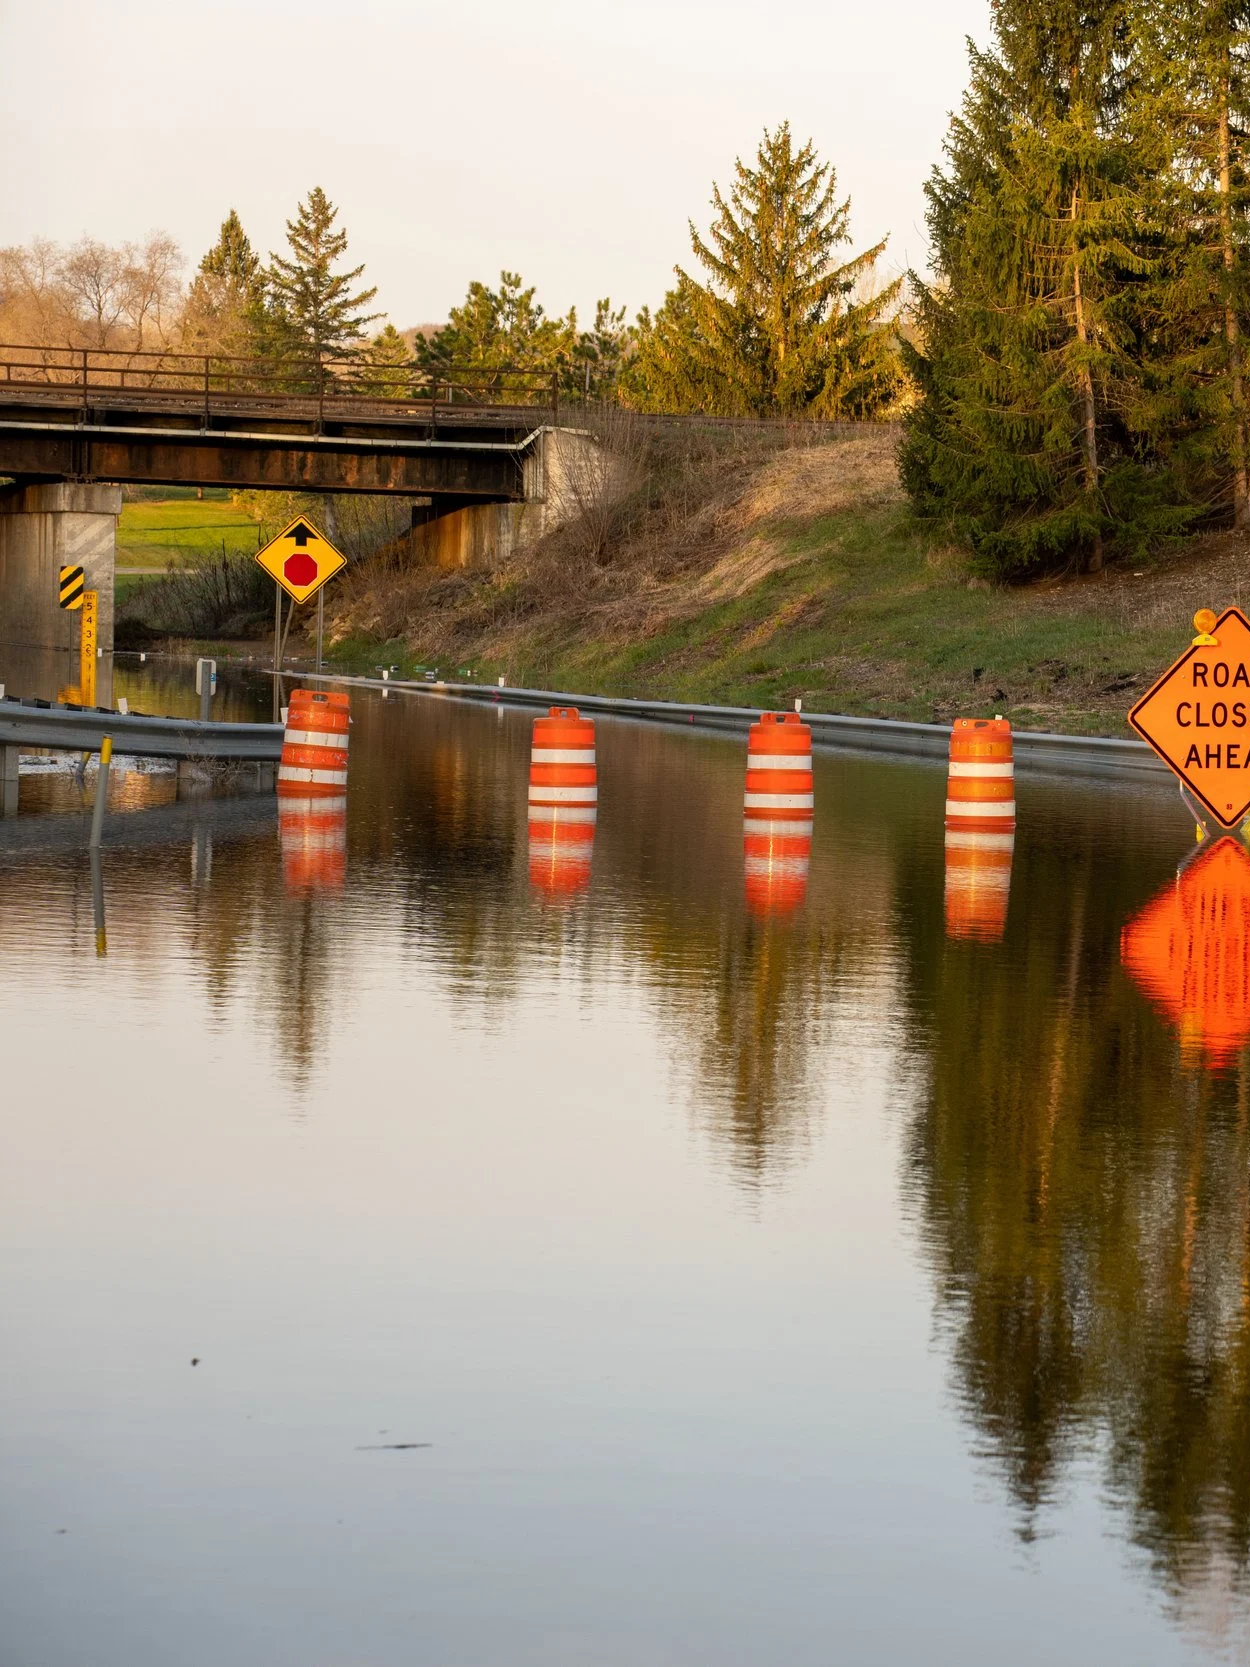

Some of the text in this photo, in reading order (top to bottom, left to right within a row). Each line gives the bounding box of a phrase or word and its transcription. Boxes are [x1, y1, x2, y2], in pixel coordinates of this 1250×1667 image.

[86, 602, 92, 610] 5
[86, 616, 92, 624] 4
[86, 630, 92, 638] 3
